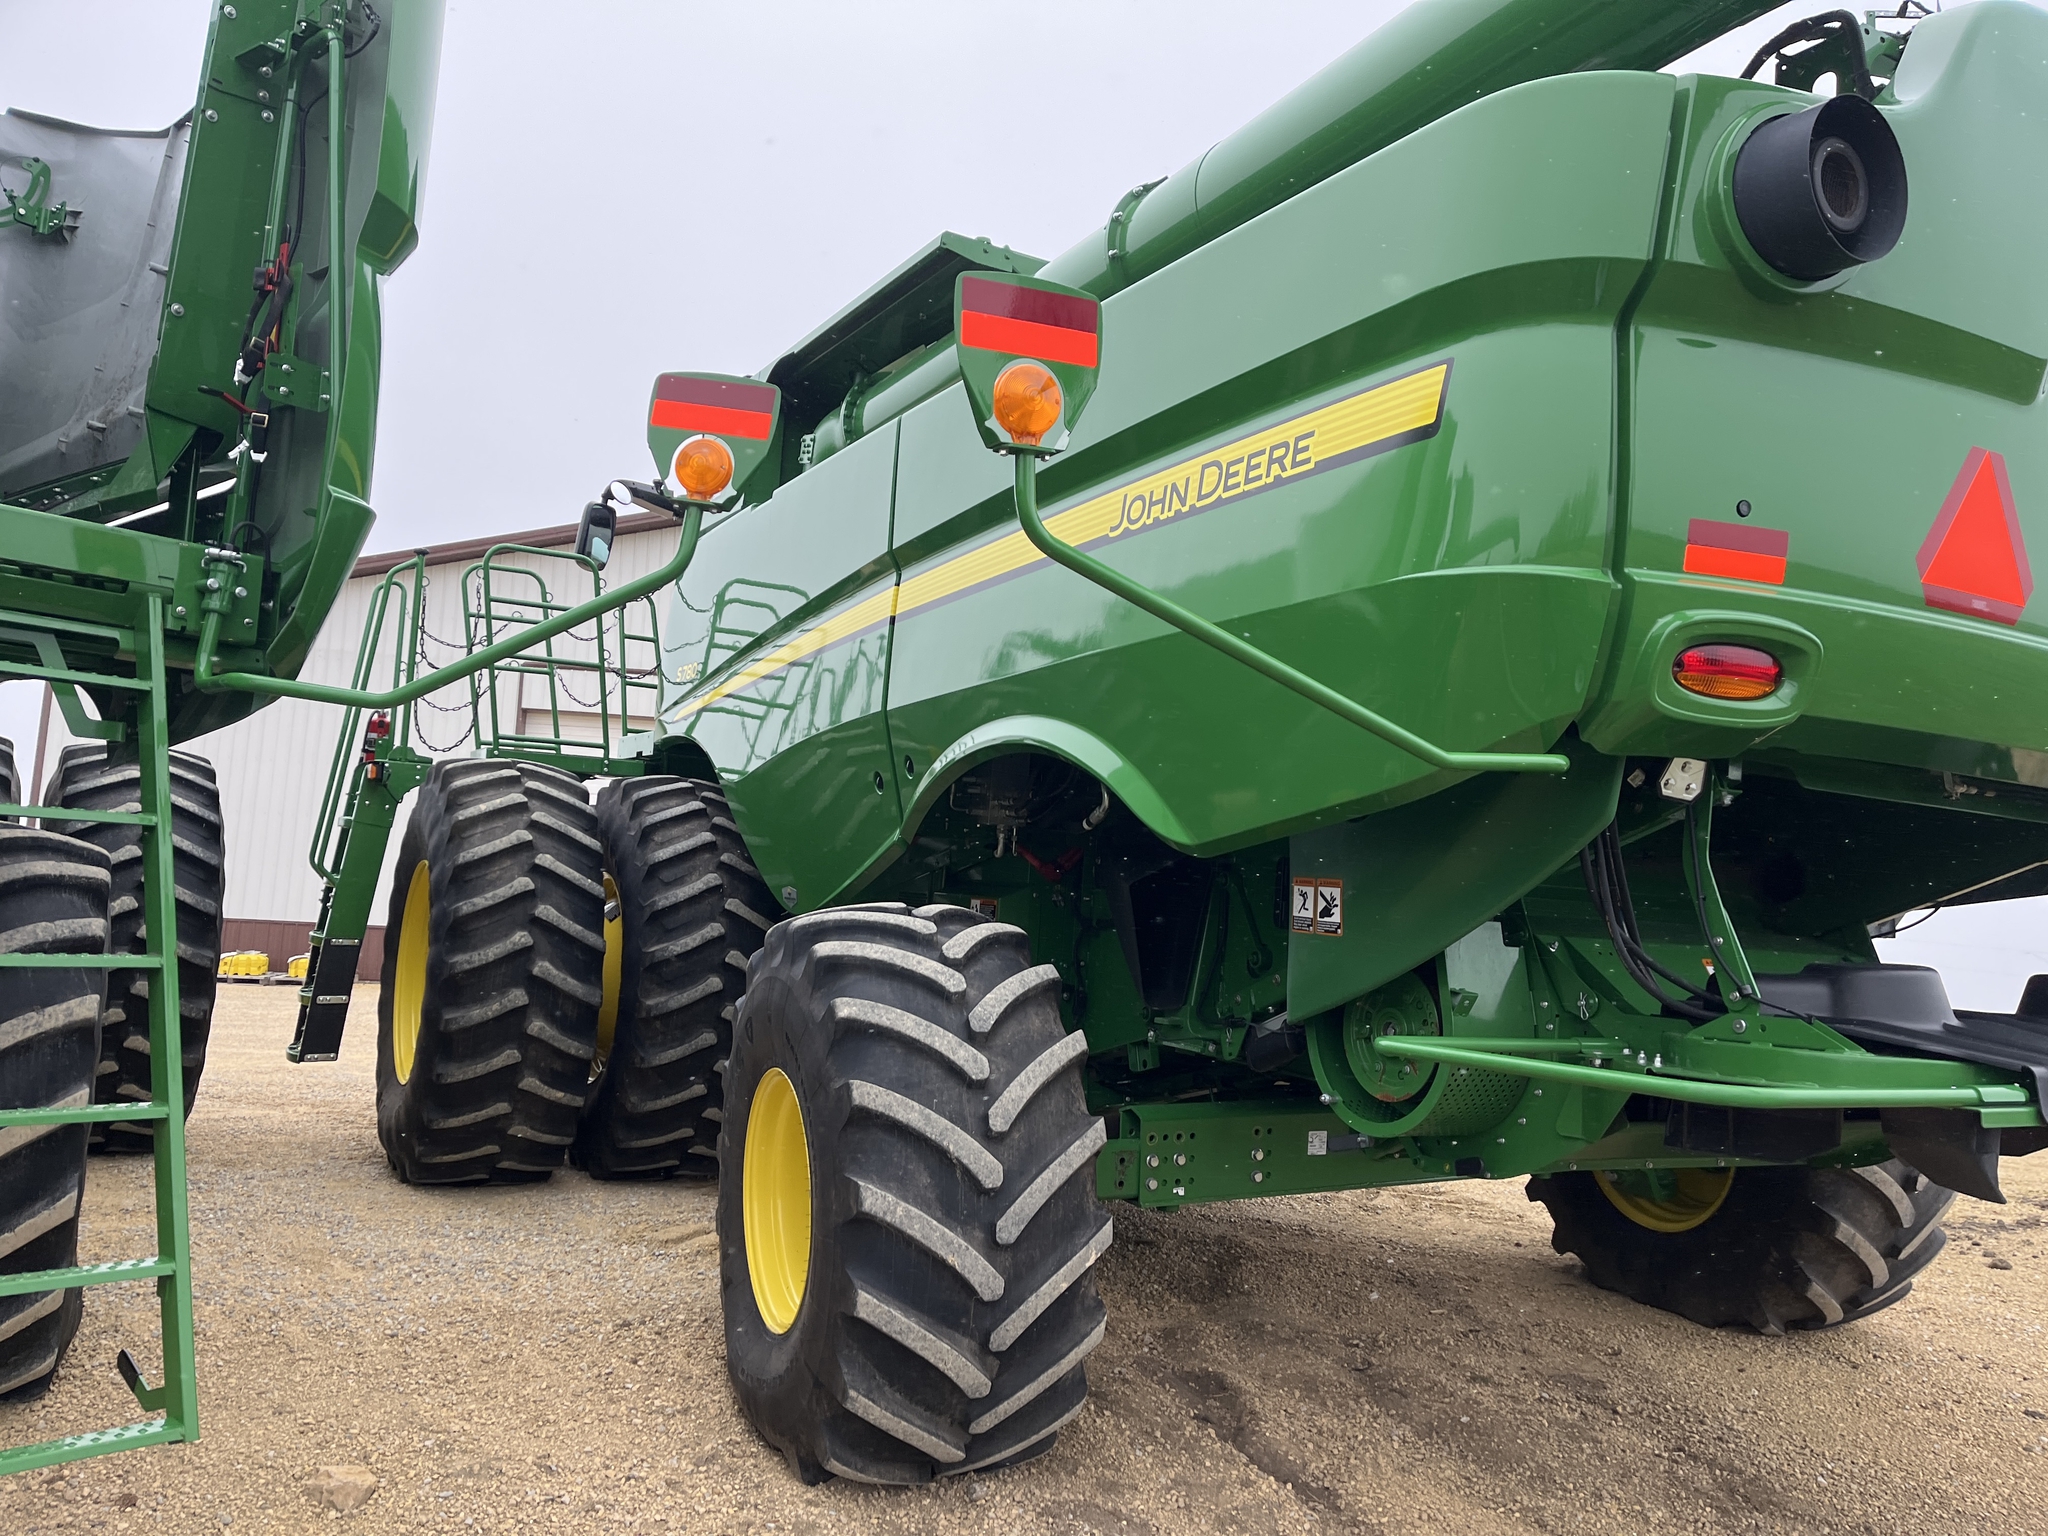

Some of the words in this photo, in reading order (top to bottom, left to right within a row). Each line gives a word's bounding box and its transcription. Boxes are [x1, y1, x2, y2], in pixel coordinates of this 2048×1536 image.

[1108, 476, 1191, 535] JOHN
[1196, 429, 1317, 505] DEERE
[676, 661, 698, 682] S780
